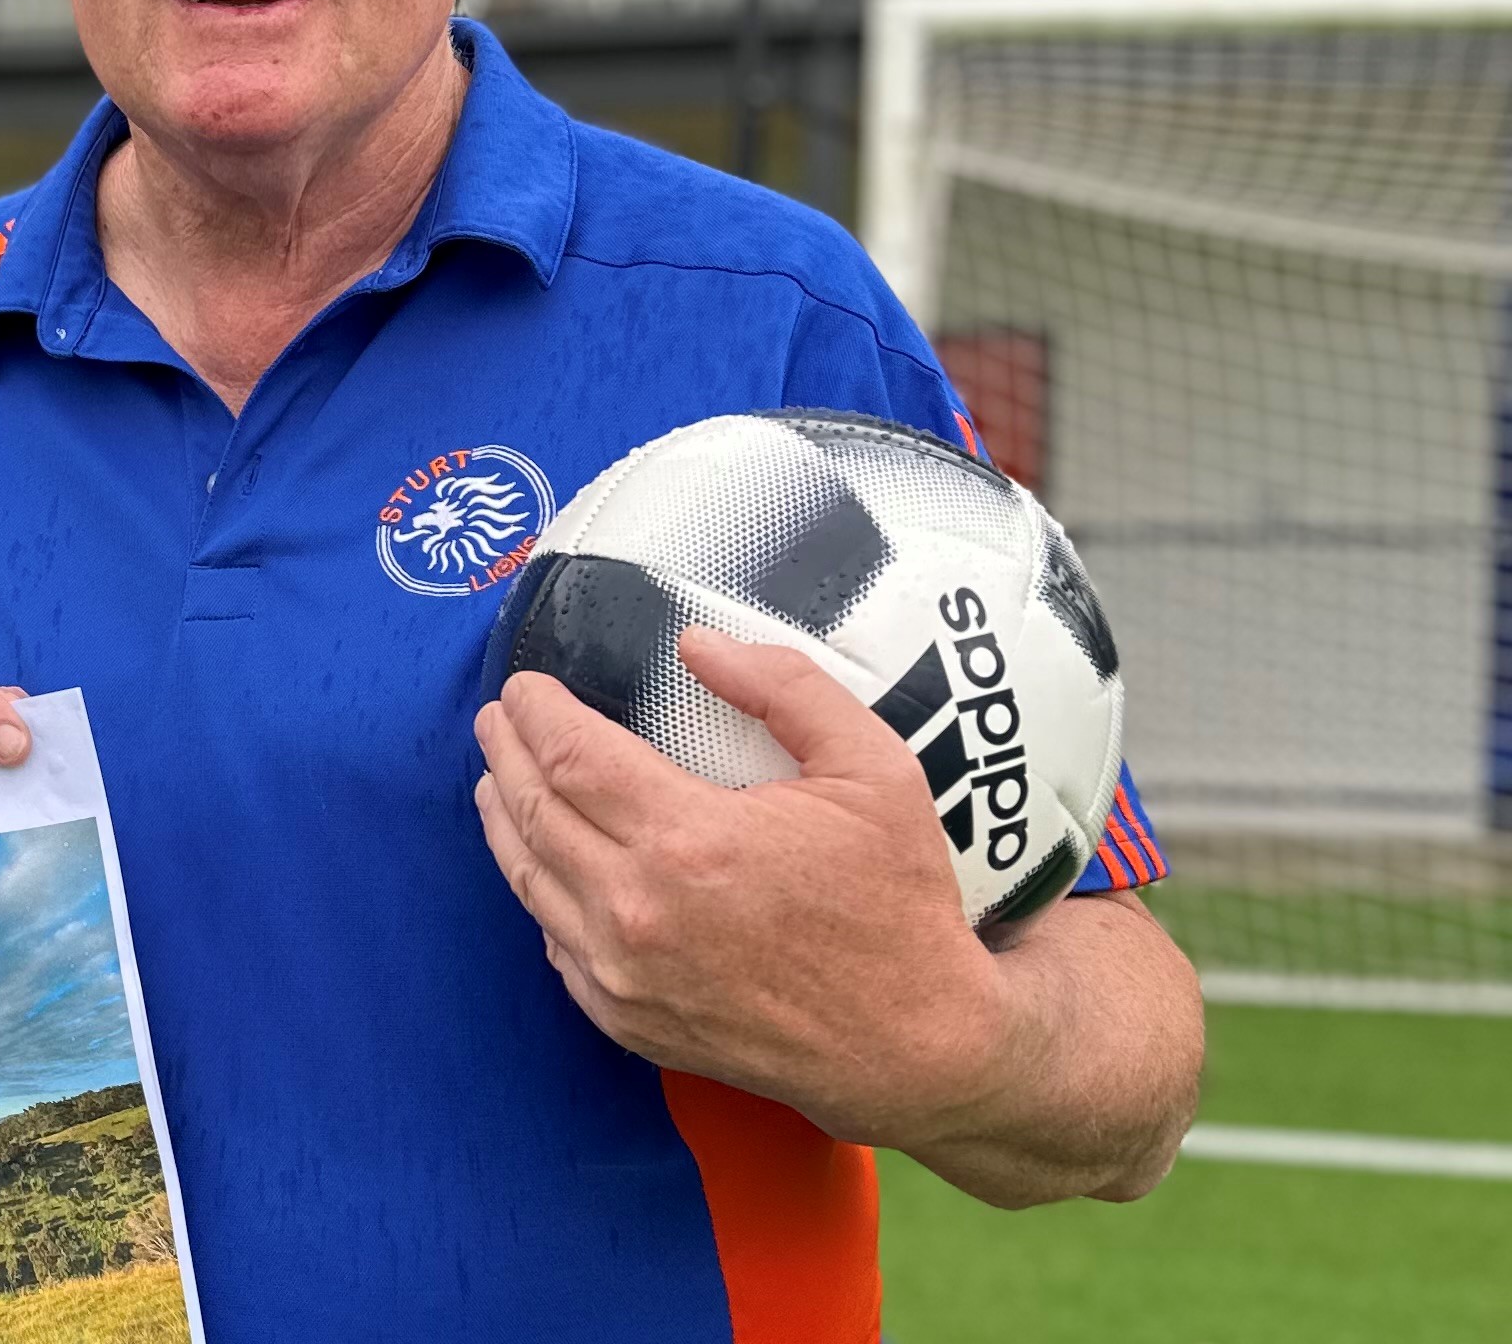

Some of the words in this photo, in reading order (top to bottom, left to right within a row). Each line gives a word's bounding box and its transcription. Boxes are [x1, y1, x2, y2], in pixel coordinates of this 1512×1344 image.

[378, 449, 472, 524] STURT
[469, 535, 539, 592] LIONS
[938, 587, 1029, 871] adidas
